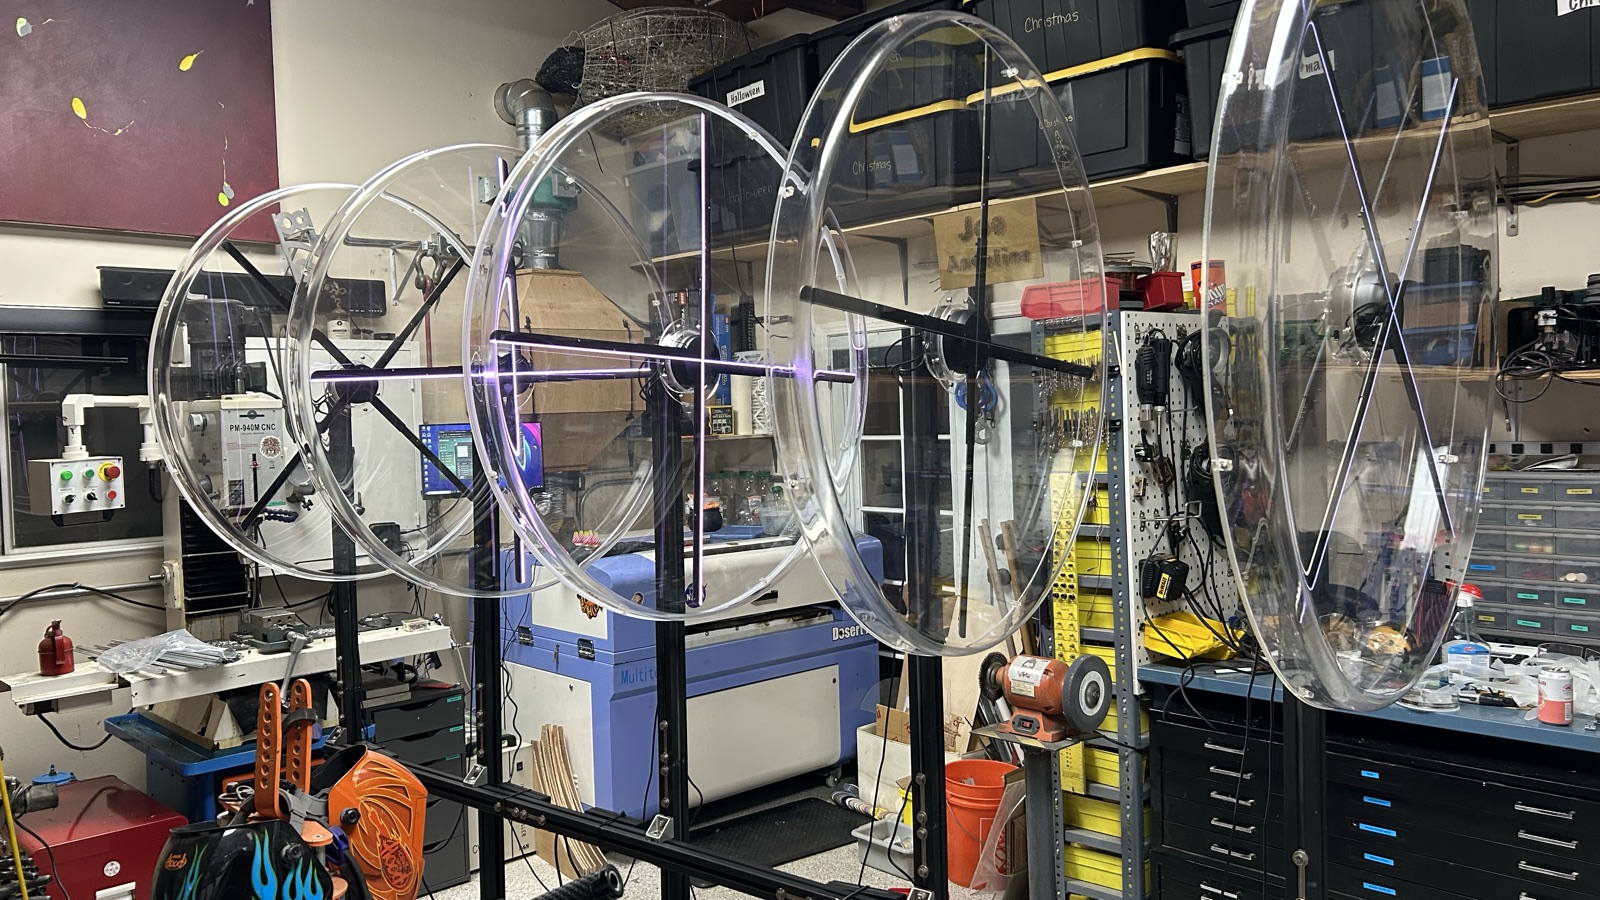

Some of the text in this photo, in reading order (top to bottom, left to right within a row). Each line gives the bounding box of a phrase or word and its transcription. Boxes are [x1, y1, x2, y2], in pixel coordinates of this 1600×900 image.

[1024, 11, 1079, 33] Christmas
[730, 85, 761, 104] Halloween
[852, 160, 892, 175] Christmas
[728, 185, 773, 204] Halloween
[229, 423, 276, 432] PM-940M CNC
[621, 666, 657, 685] Multit
